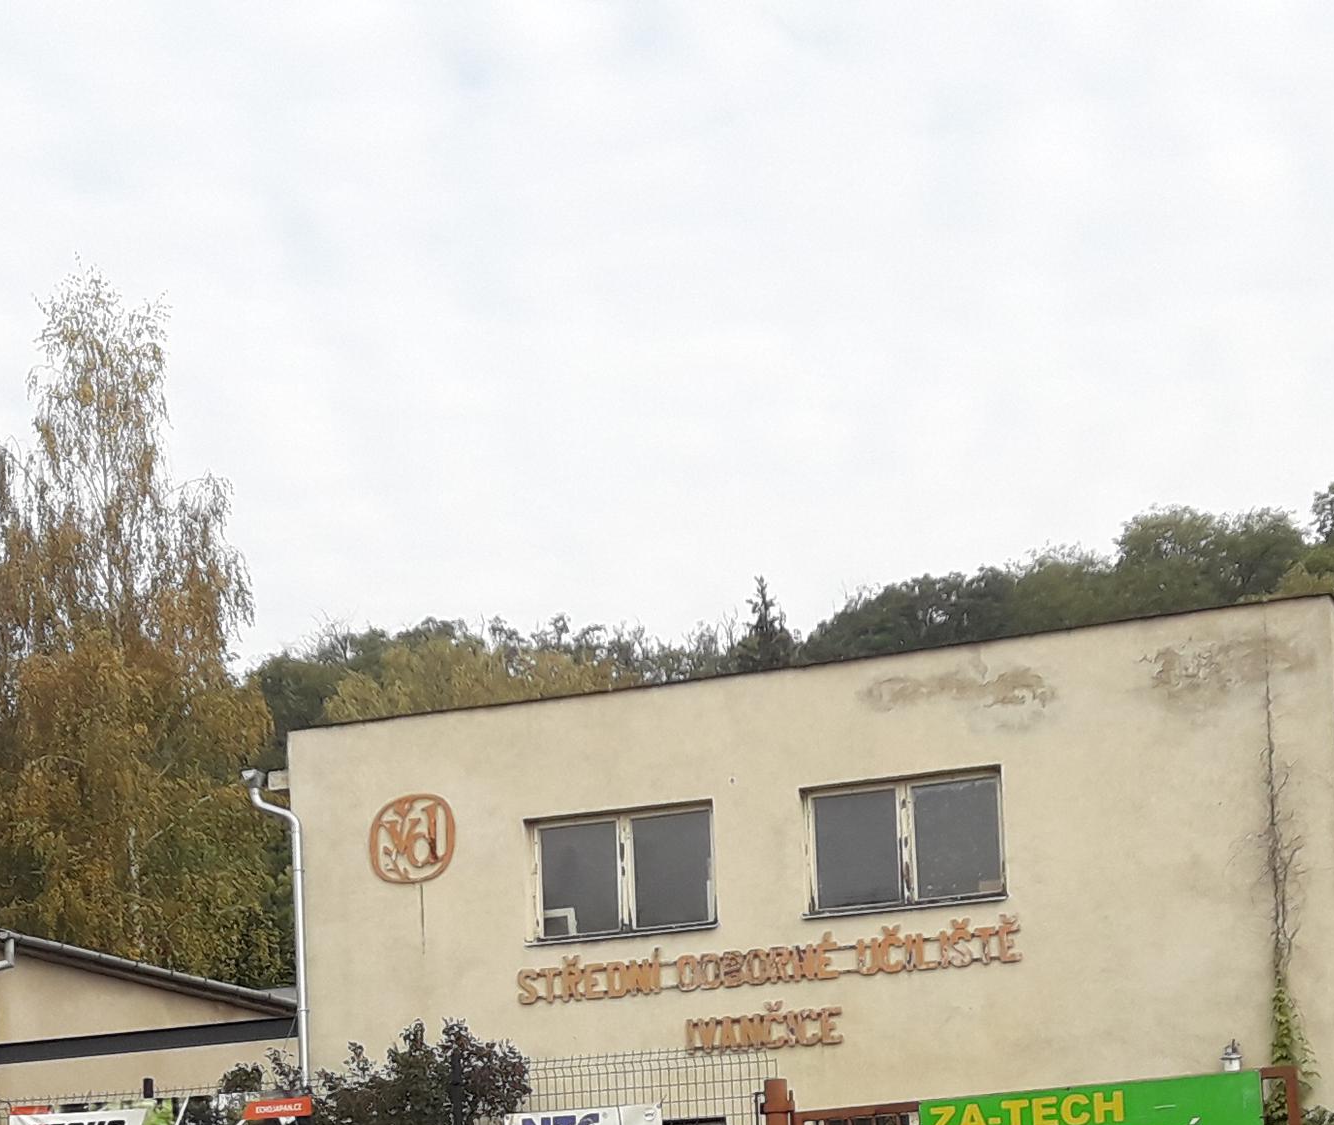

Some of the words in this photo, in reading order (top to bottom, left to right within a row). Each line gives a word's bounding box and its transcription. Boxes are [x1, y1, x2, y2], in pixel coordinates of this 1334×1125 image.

[517, 948, 662, 1005] STŘEDNÍ
[676, 931, 840, 992] ODBORNÉ
[857, 913, 1023, 976] UČILIŠTĚ
[685, 1000, 844, 1055] IVANČICE
